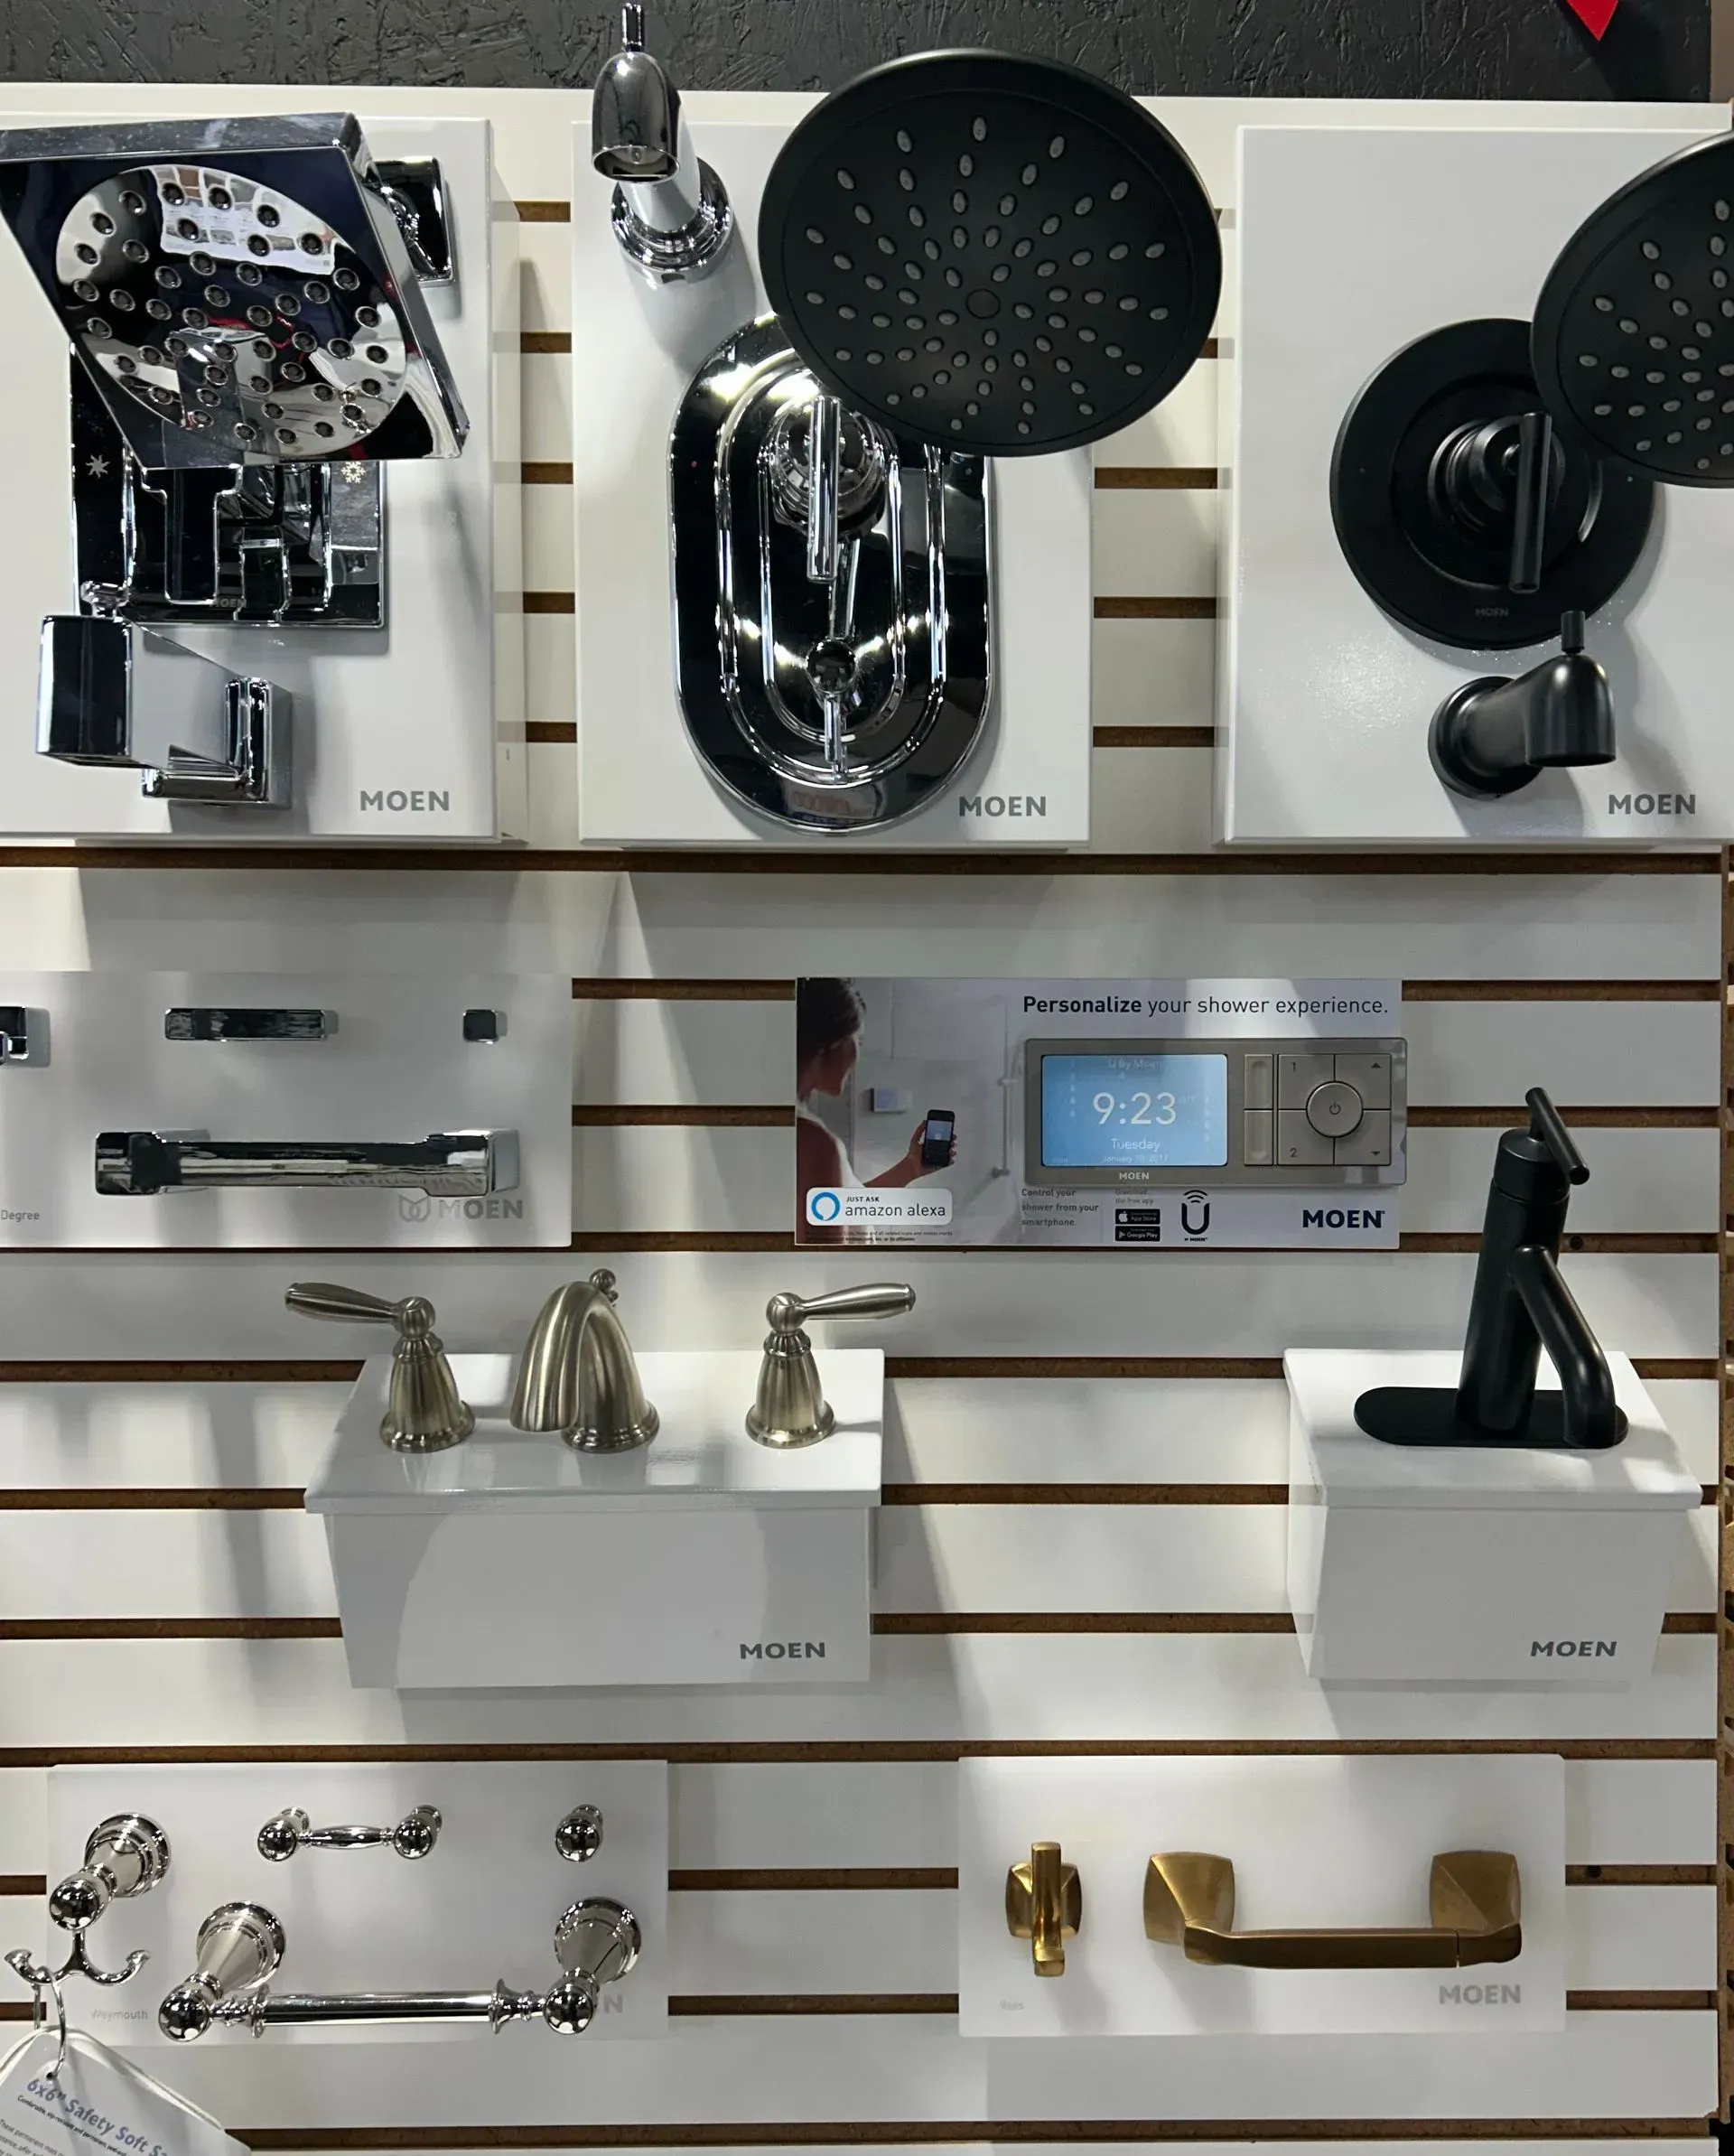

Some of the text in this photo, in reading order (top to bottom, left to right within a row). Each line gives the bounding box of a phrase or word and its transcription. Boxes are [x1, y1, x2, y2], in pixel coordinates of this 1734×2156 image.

[1475, 608, 1509, 617] MOEN
[360, 790, 450, 811] MOEN
[959, 796, 1047, 817] MOEN
[1608, 794, 1696, 815] MOEN
[1022, 996, 1389, 1018] Personalize your shower experience.
[1291, 1062, 1297, 1072] 1
[1092, 1091, 1177, 1125] 9:23
[1111, 1137, 1161, 1153] Tuesday
[1290, 1147, 1298, 1158] 2
[1119, 1172, 1150, 1181] MOEN
[1021, 1189, 1077, 1199] Control your
[1, 1209, 41, 1223] Degree
[439, 1199, 523, 1219] MOEN
[845, 1203, 946, 1217] amazon alexa
[1021, 1204, 1099, 1214] shower from your
[1021, 1218, 1077, 1227] smartphone.
[1303, 1209, 1382, 1228] MOEN
[740, 1642, 825, 1659] MOEN
[1531, 1641, 1617, 1657] MOEN
[1439, 1984, 1522, 2004] MOEN
[91, 2009, 148, 2021] Weymouth
[65, 2099, 116, 2135] Safety
[116, 2126, 149, 2152] Soft
